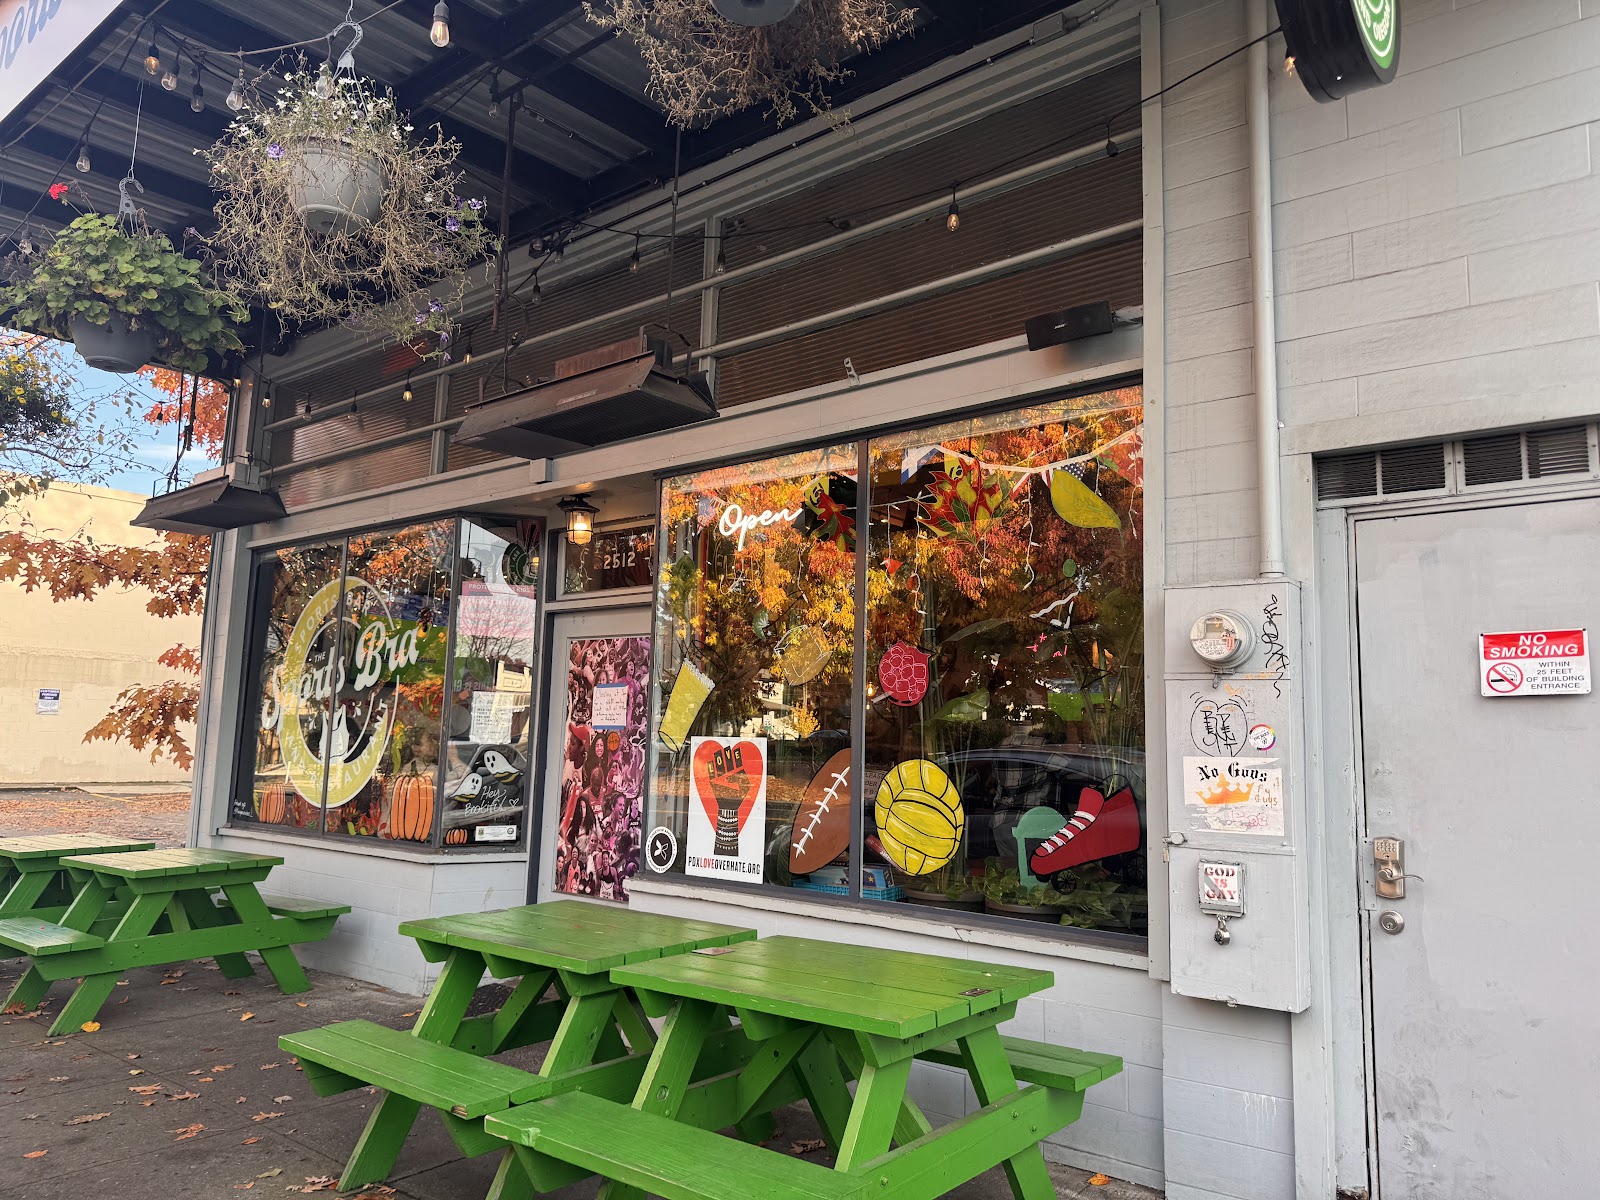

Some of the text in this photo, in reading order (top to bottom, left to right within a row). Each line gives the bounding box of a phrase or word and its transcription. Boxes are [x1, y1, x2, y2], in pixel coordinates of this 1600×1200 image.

[719, 504, 803, 551] Open
[603, 552, 636, 570] 2512
[294, 591, 371, 655] SPORTS BAR
[1518, 634, 1547, 646] NO
[314, 651, 326, 663] THE
[1490, 644, 1578, 658] SMOKING
[261, 620, 420, 735] Sports Bra
[707, 750, 740, 773] LOVE
[1196, 765, 1219, 782] No
[480, 786, 506, 800] Hey
[688, 856, 761, 875] PDXLOVEOVERHATE.ORG
[1204, 866, 1236, 878] GOD
[1214, 878, 1228, 888] IS
[1206, 889, 1237, 900] GAY
